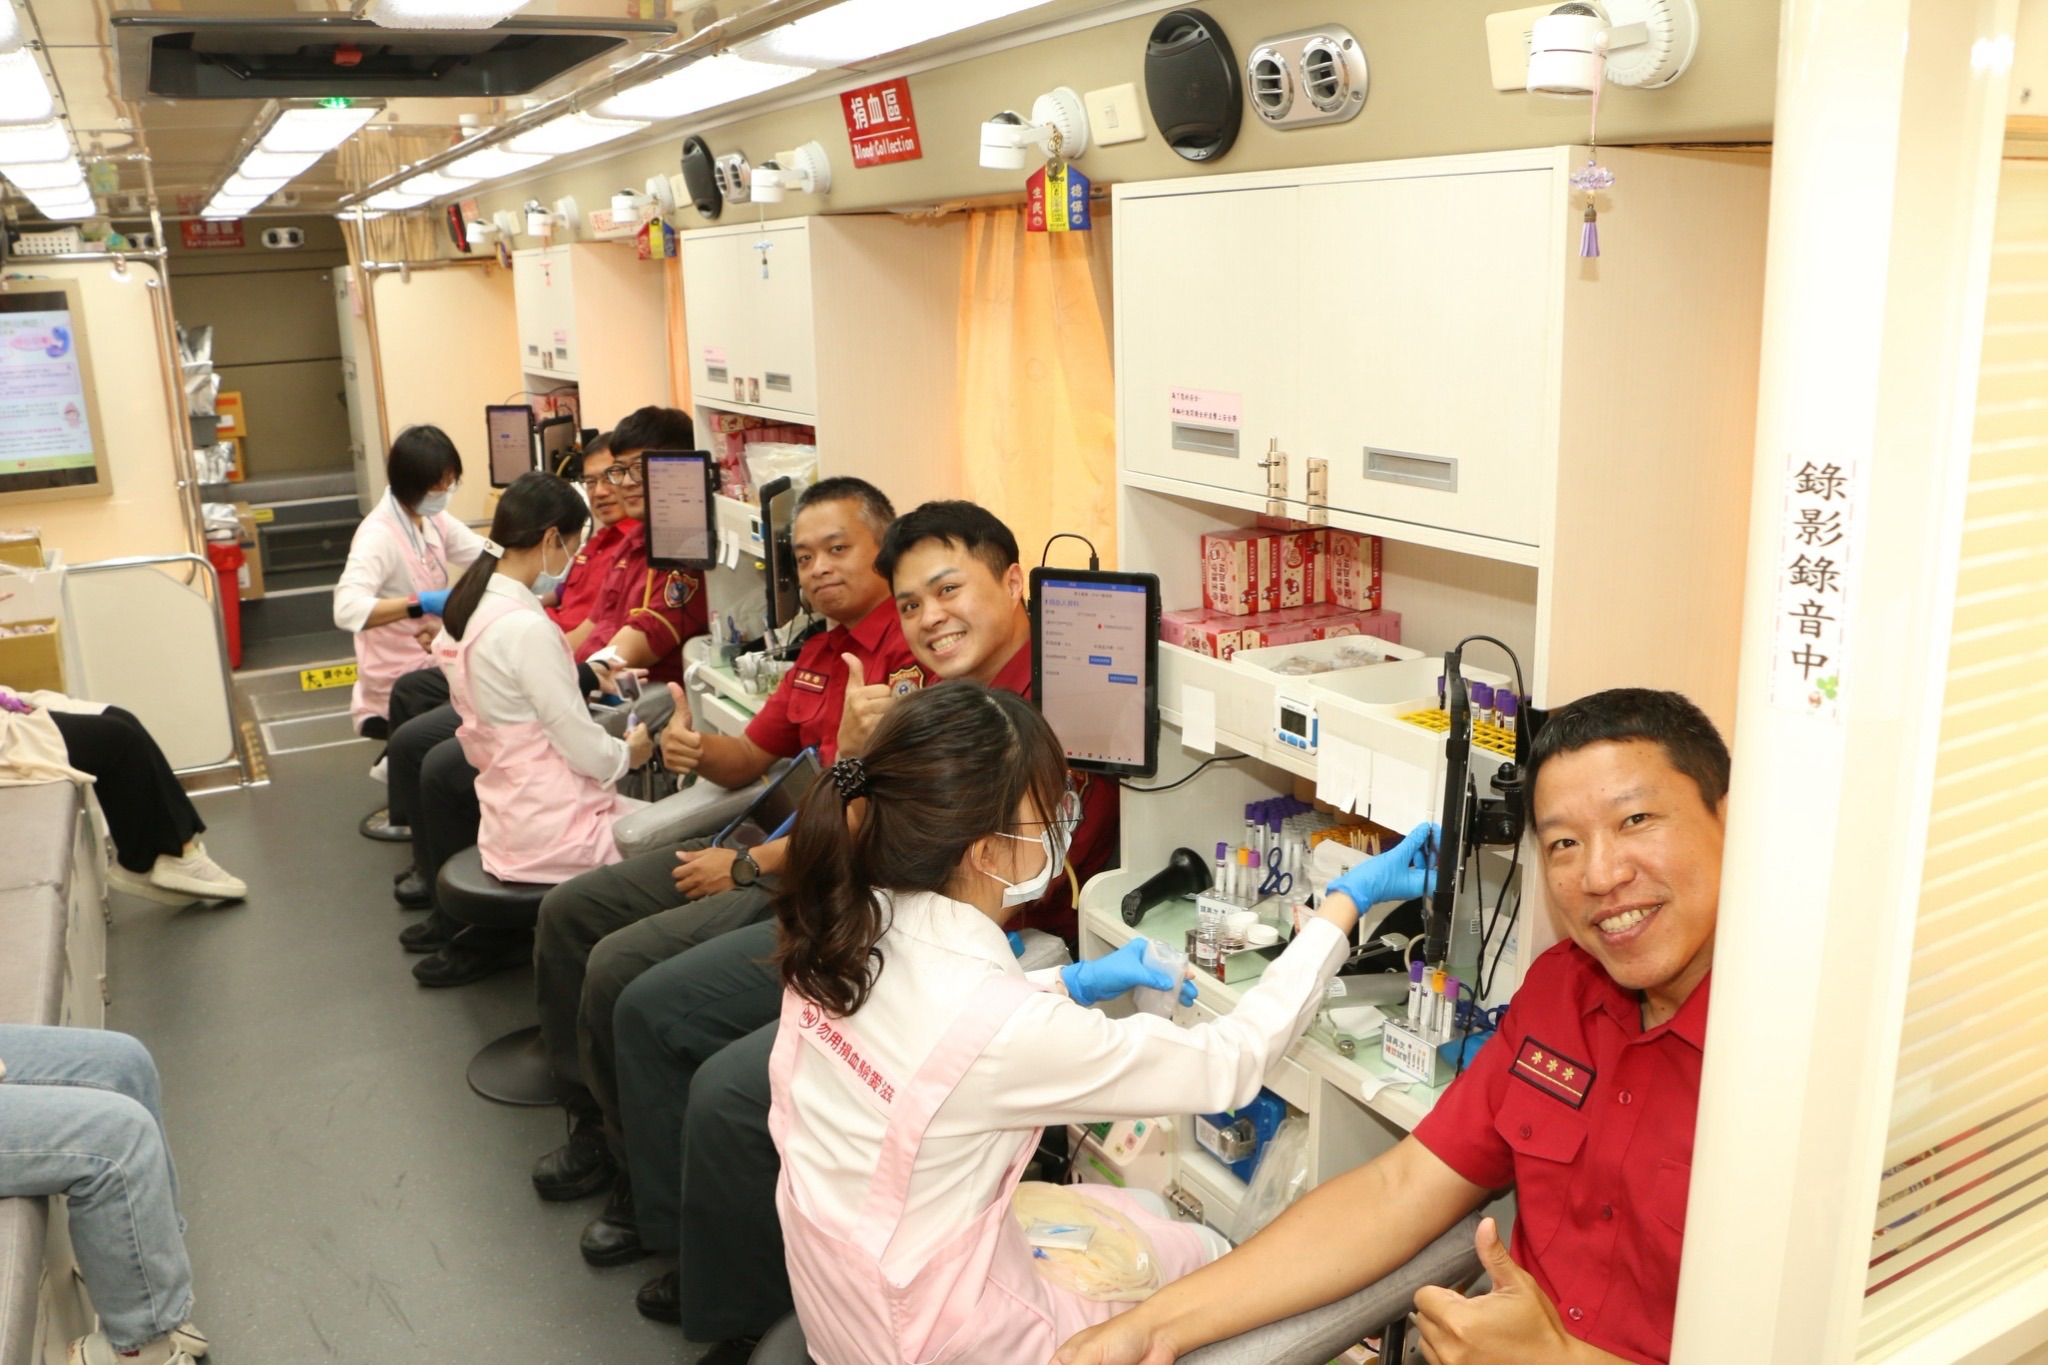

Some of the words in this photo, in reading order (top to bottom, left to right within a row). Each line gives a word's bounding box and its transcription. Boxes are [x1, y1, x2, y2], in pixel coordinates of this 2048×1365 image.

[850, 87, 902, 130] 捐血區
[853, 141, 875, 160] Blood
[874, 135, 915, 156] Collection
[1787, 460, 1848, 680] 錄影錄音中
[816, 1022, 895, 1104] 勿用捐血驗愛滋
